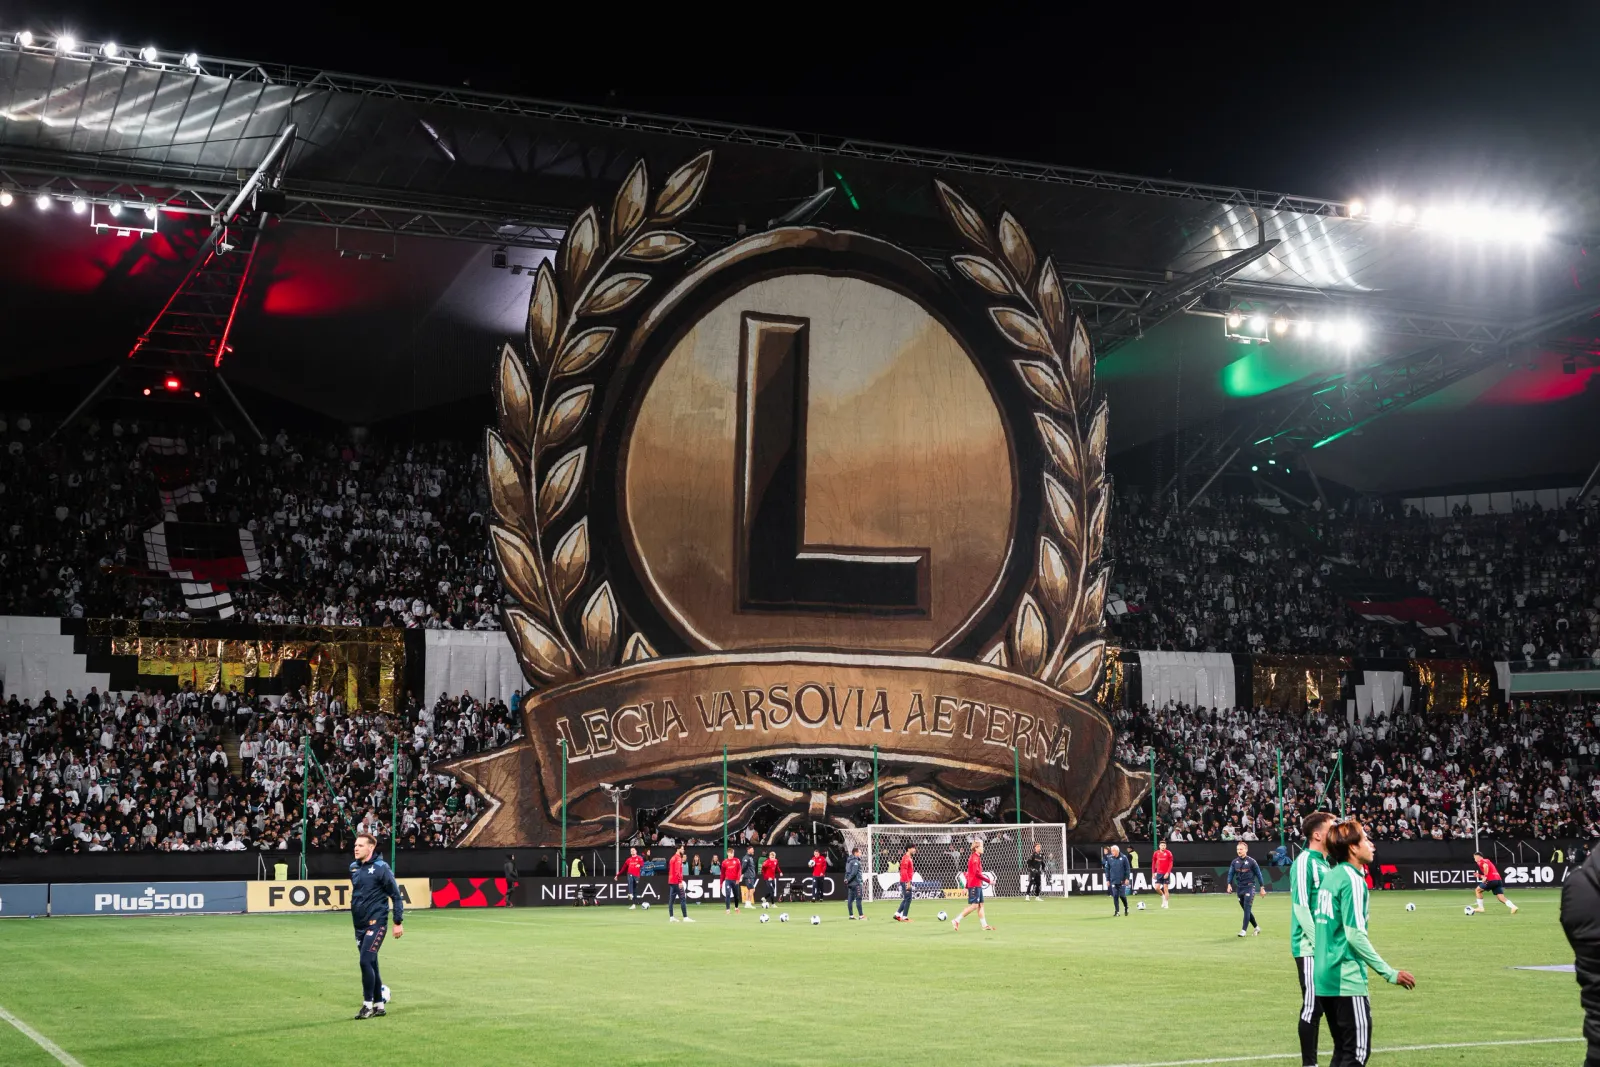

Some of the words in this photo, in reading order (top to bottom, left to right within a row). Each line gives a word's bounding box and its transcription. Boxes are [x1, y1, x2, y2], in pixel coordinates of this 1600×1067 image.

[734, 311, 932, 619] L
[556, 697, 688, 763] LEGIA
[694, 683, 892, 733] VARSOVIA
[902, 692, 1071, 770] AETERNA
[1020, 872, 1193, 892] BLETY.LA.OM
[1414, 869, 1482, 884] NIEDZIEL
[1504, 867, 1554, 883] 25.10
[95, 888, 204, 911] Plus500
[269, 885, 411, 907] FORTA
[541, 883, 660, 900] NIEZIEA,
